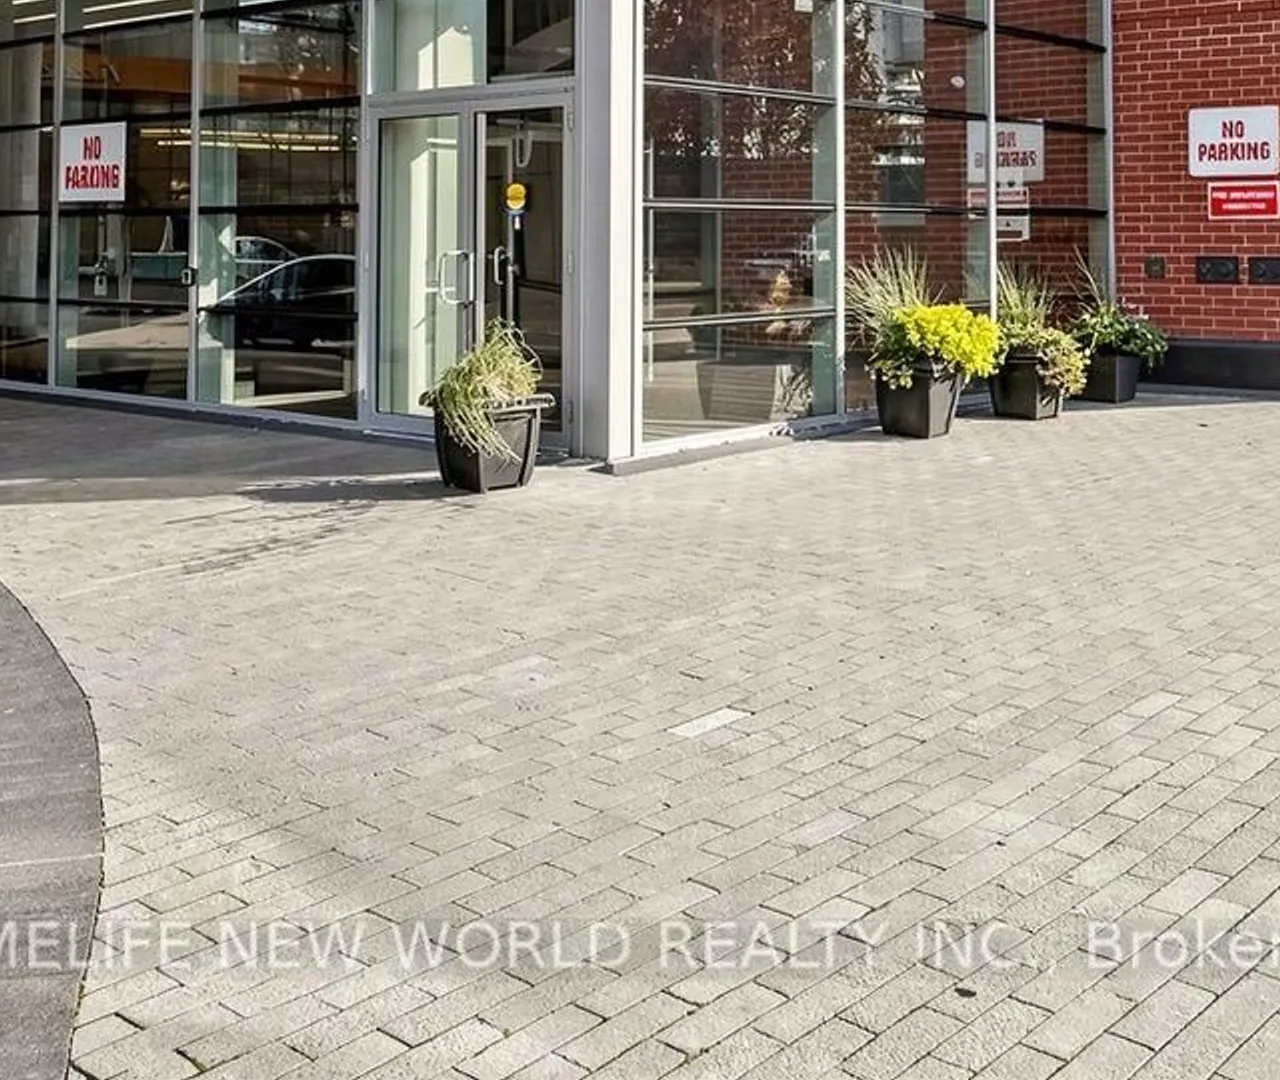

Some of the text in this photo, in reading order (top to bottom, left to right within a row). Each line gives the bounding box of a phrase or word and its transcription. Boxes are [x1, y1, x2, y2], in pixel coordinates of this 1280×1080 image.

[1222, 120, 1245, 138] NO
[83, 136, 101, 160] NO
[1198, 141, 1270, 162] PARKING
[65, 164, 120, 189] PARKING
